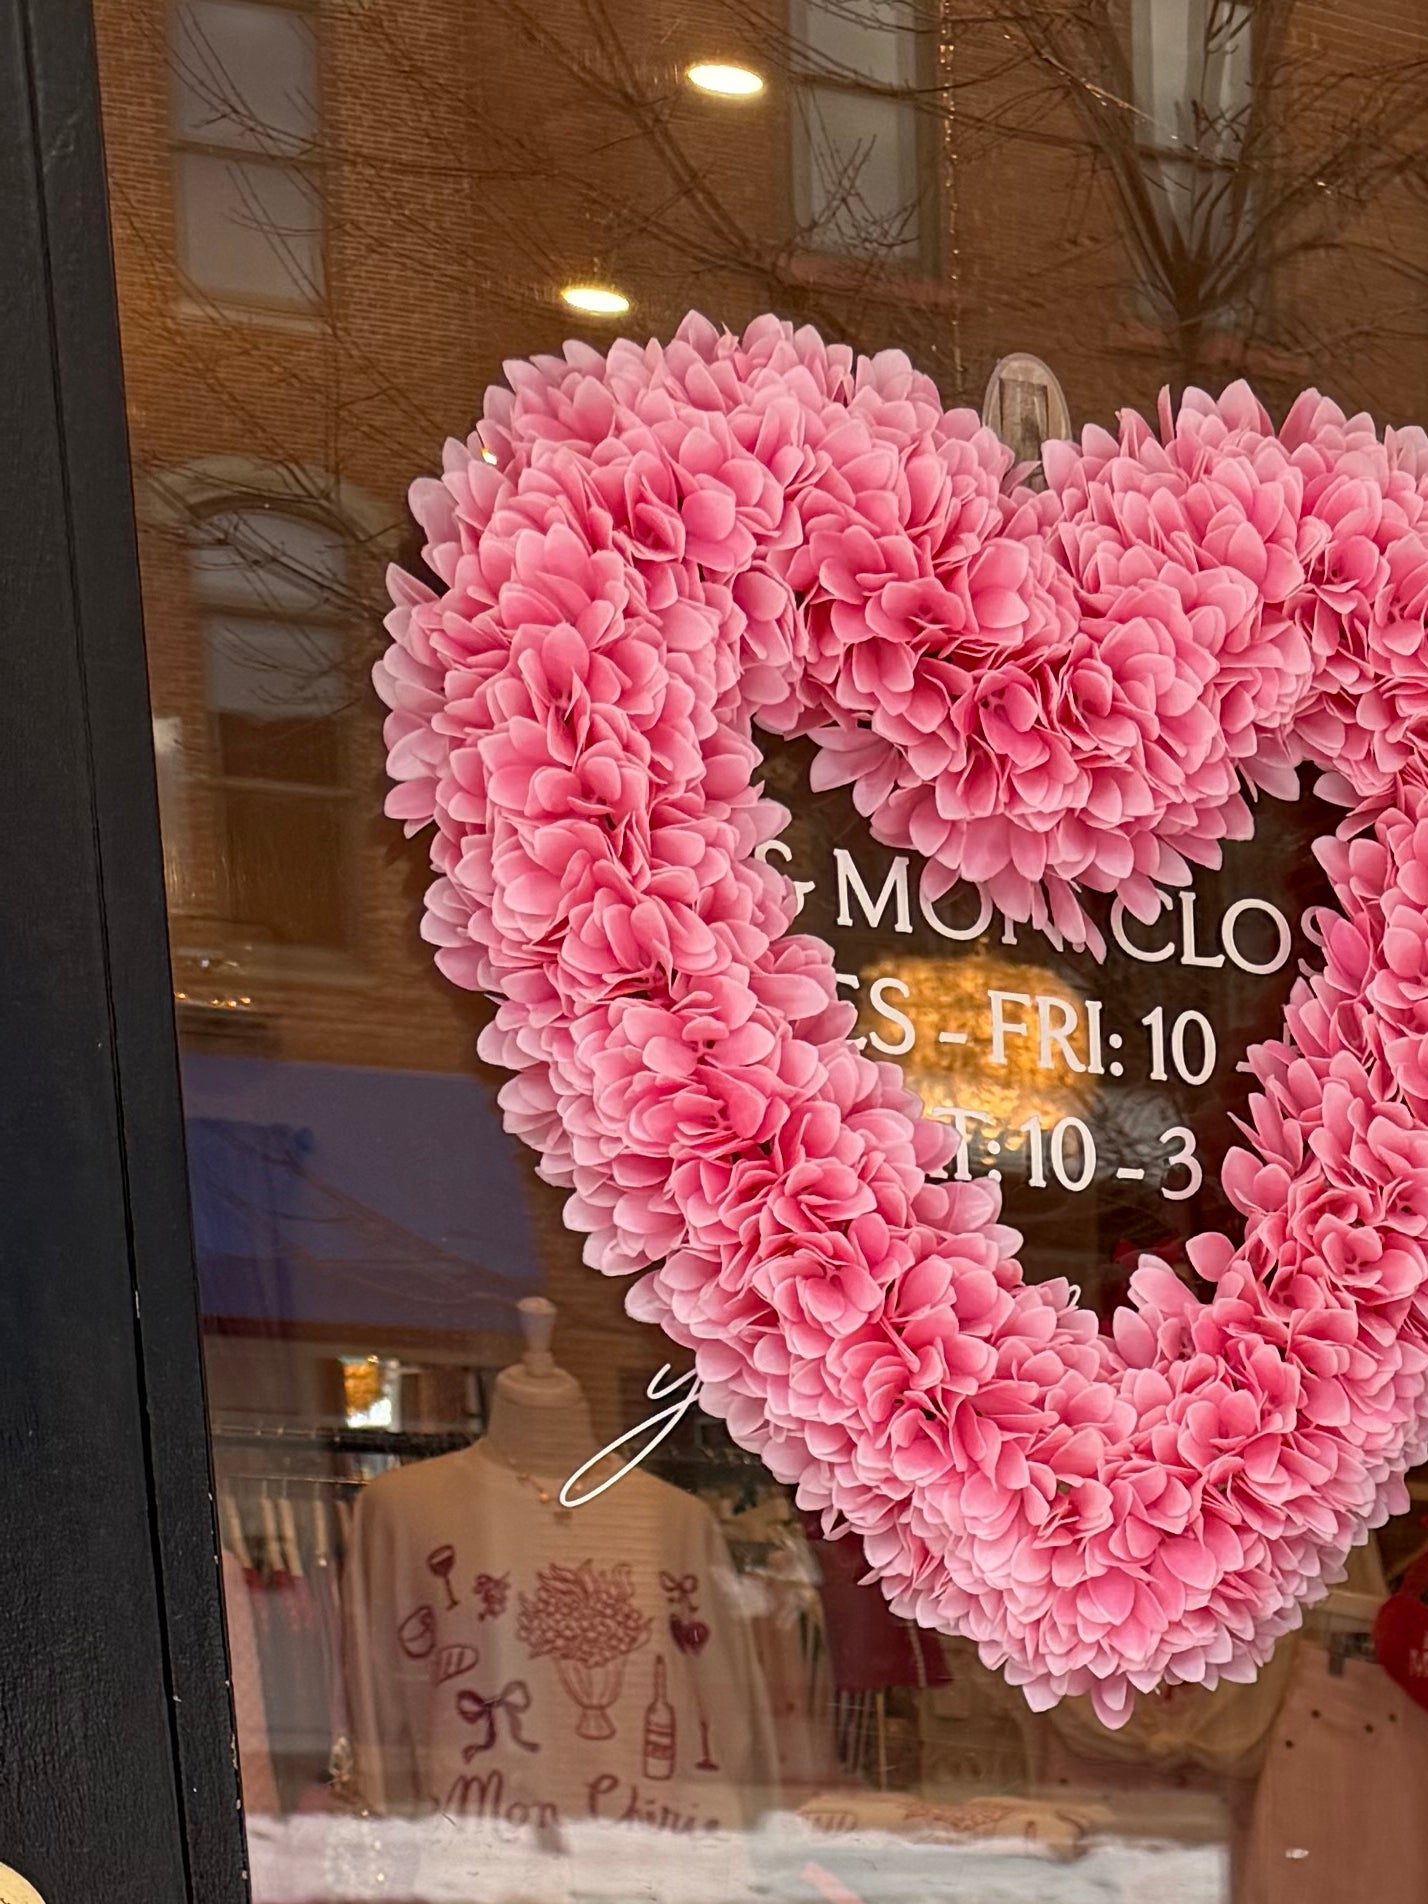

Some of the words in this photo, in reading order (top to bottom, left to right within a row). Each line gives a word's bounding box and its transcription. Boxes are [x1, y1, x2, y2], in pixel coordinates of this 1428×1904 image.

[987, 989, 1124, 1077] FRI:
[1141, 1006, 1217, 1087] 10
[1020, 1114, 1097, 1192] 10
[1159, 1126, 1203, 1201] 3
